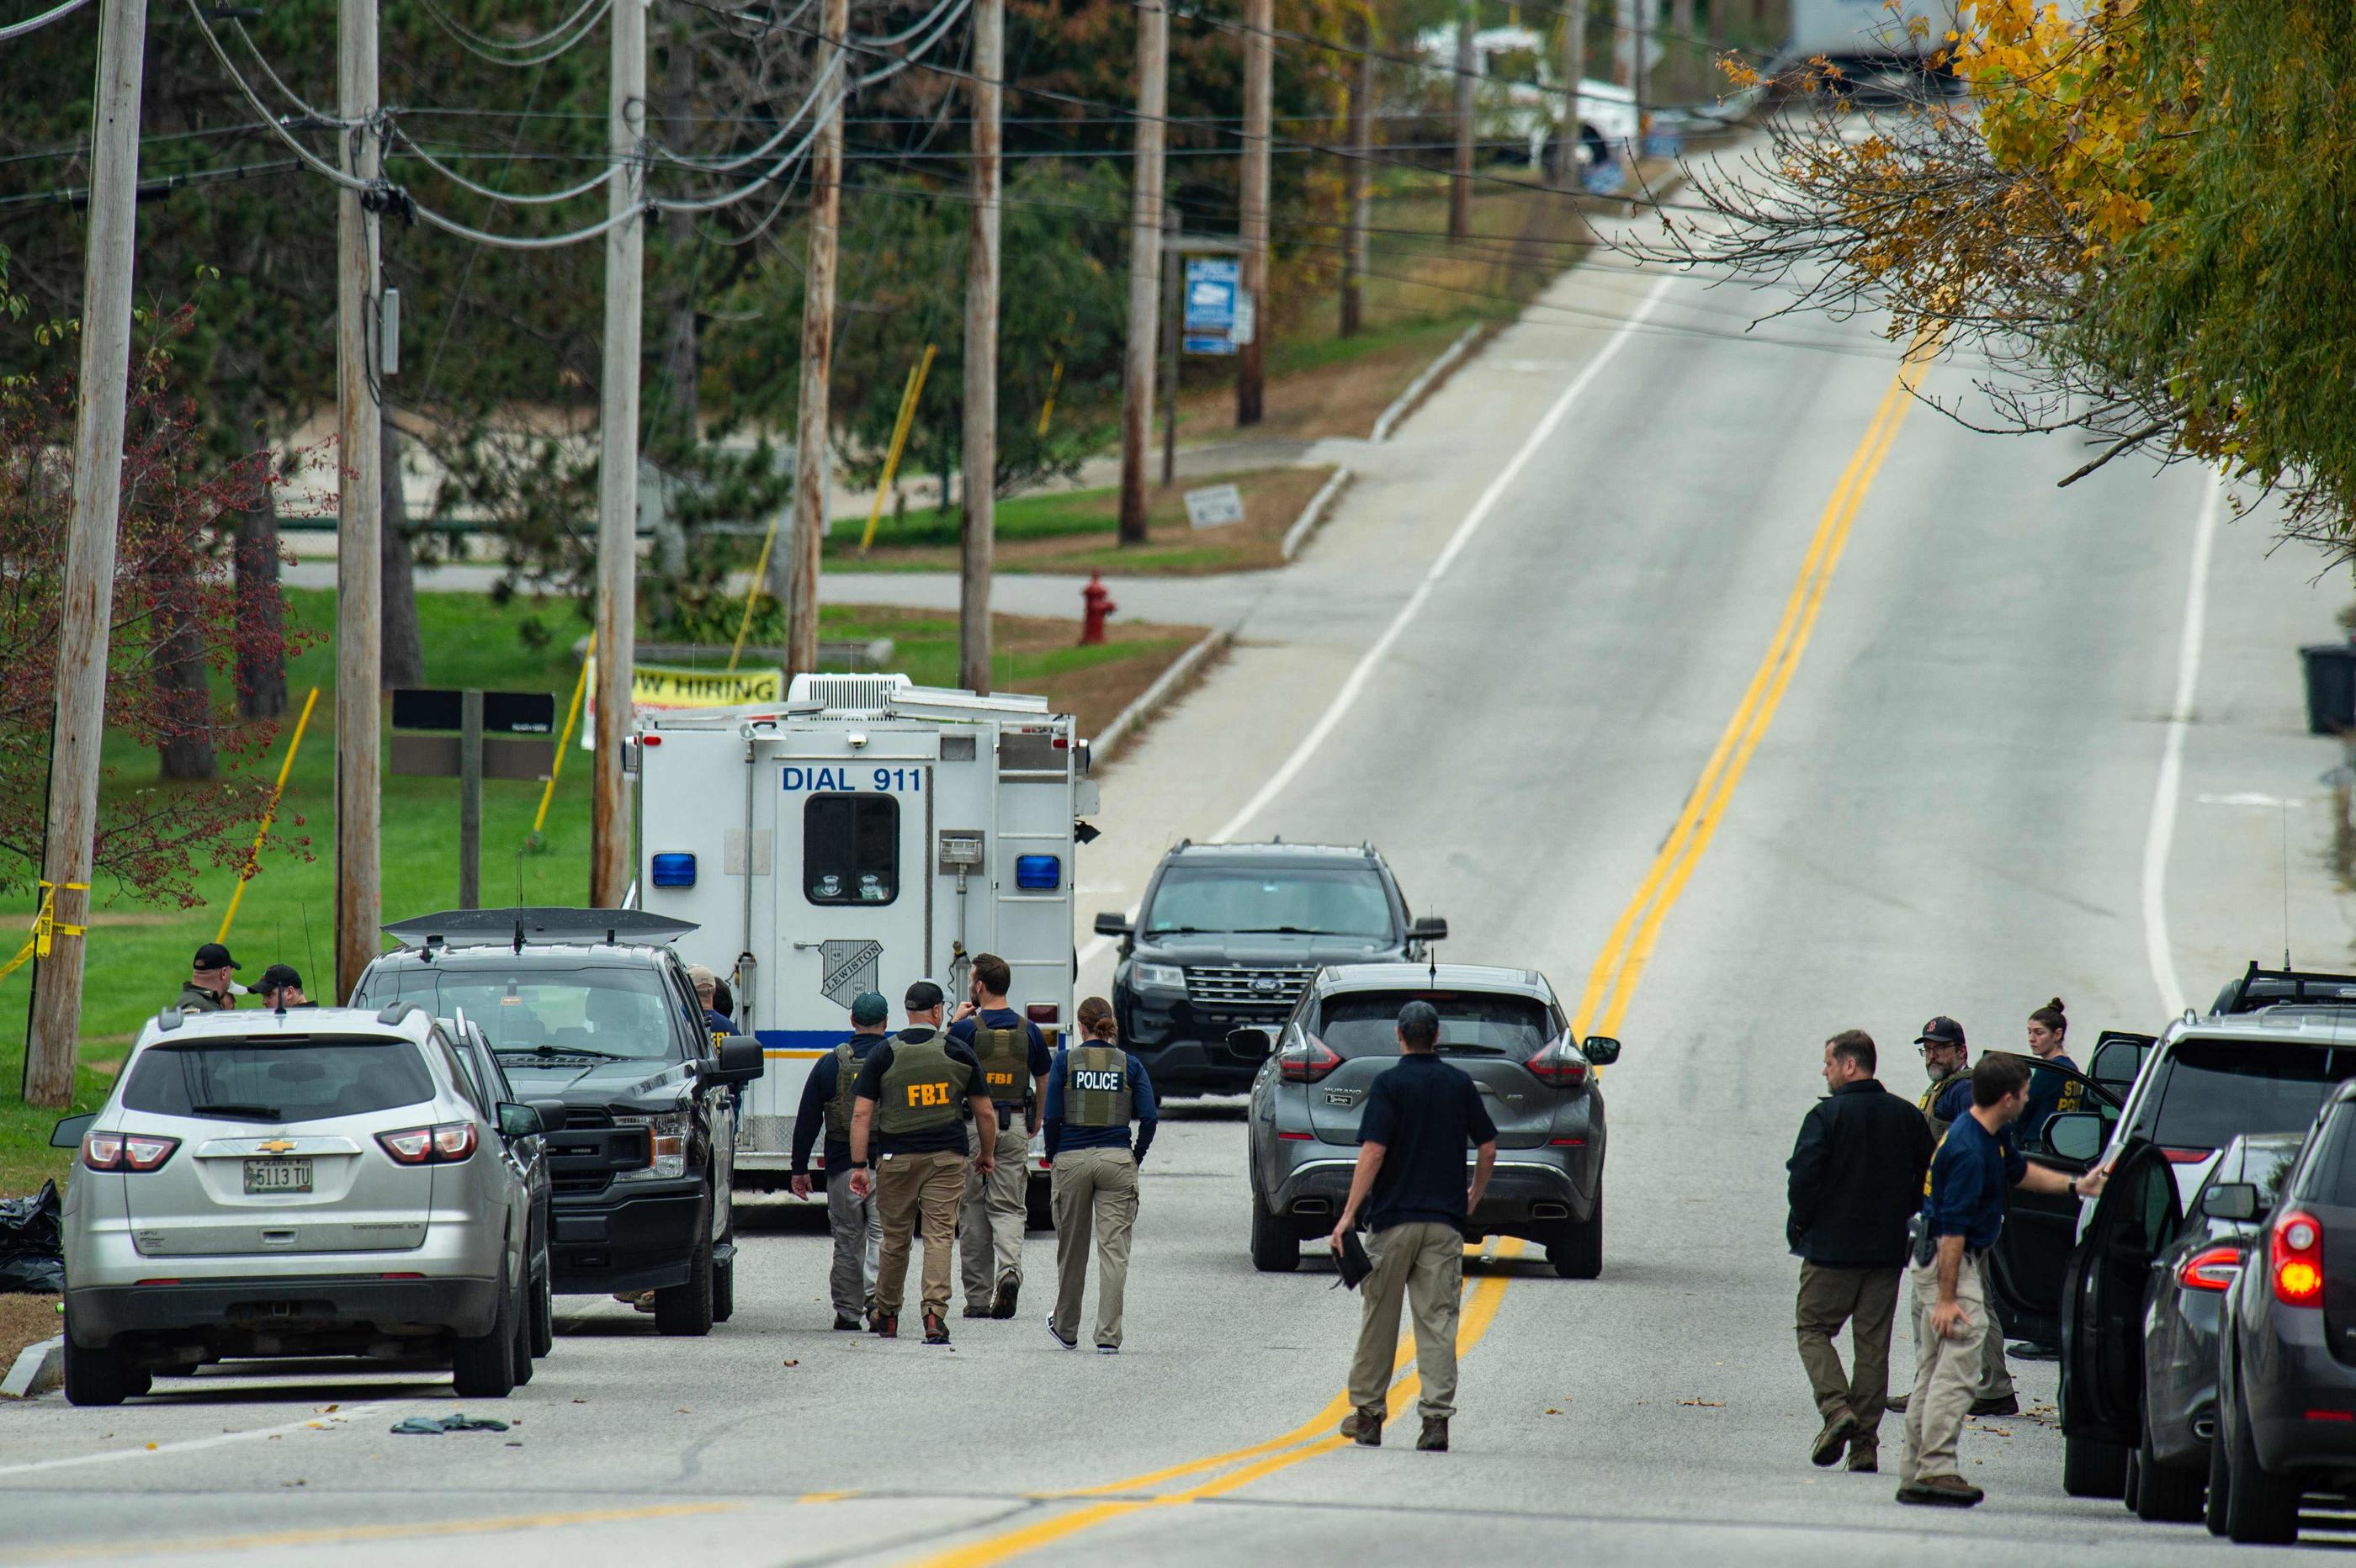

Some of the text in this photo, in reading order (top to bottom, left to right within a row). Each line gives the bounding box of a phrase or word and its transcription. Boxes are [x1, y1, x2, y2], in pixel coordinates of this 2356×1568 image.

[675, 675, 774, 701] HIRING
[783, 767, 920, 792] DIAL 911
[825, 944, 880, 991] LEWISTON
[986, 1073, 1013, 1084] FBI
[1076, 1071, 1118, 1091] POLICE
[907, 1082, 950, 1107] FBI
[1324, 1087, 1362, 1095] MURANO
[257, 1168, 310, 1185] 5113 TU
